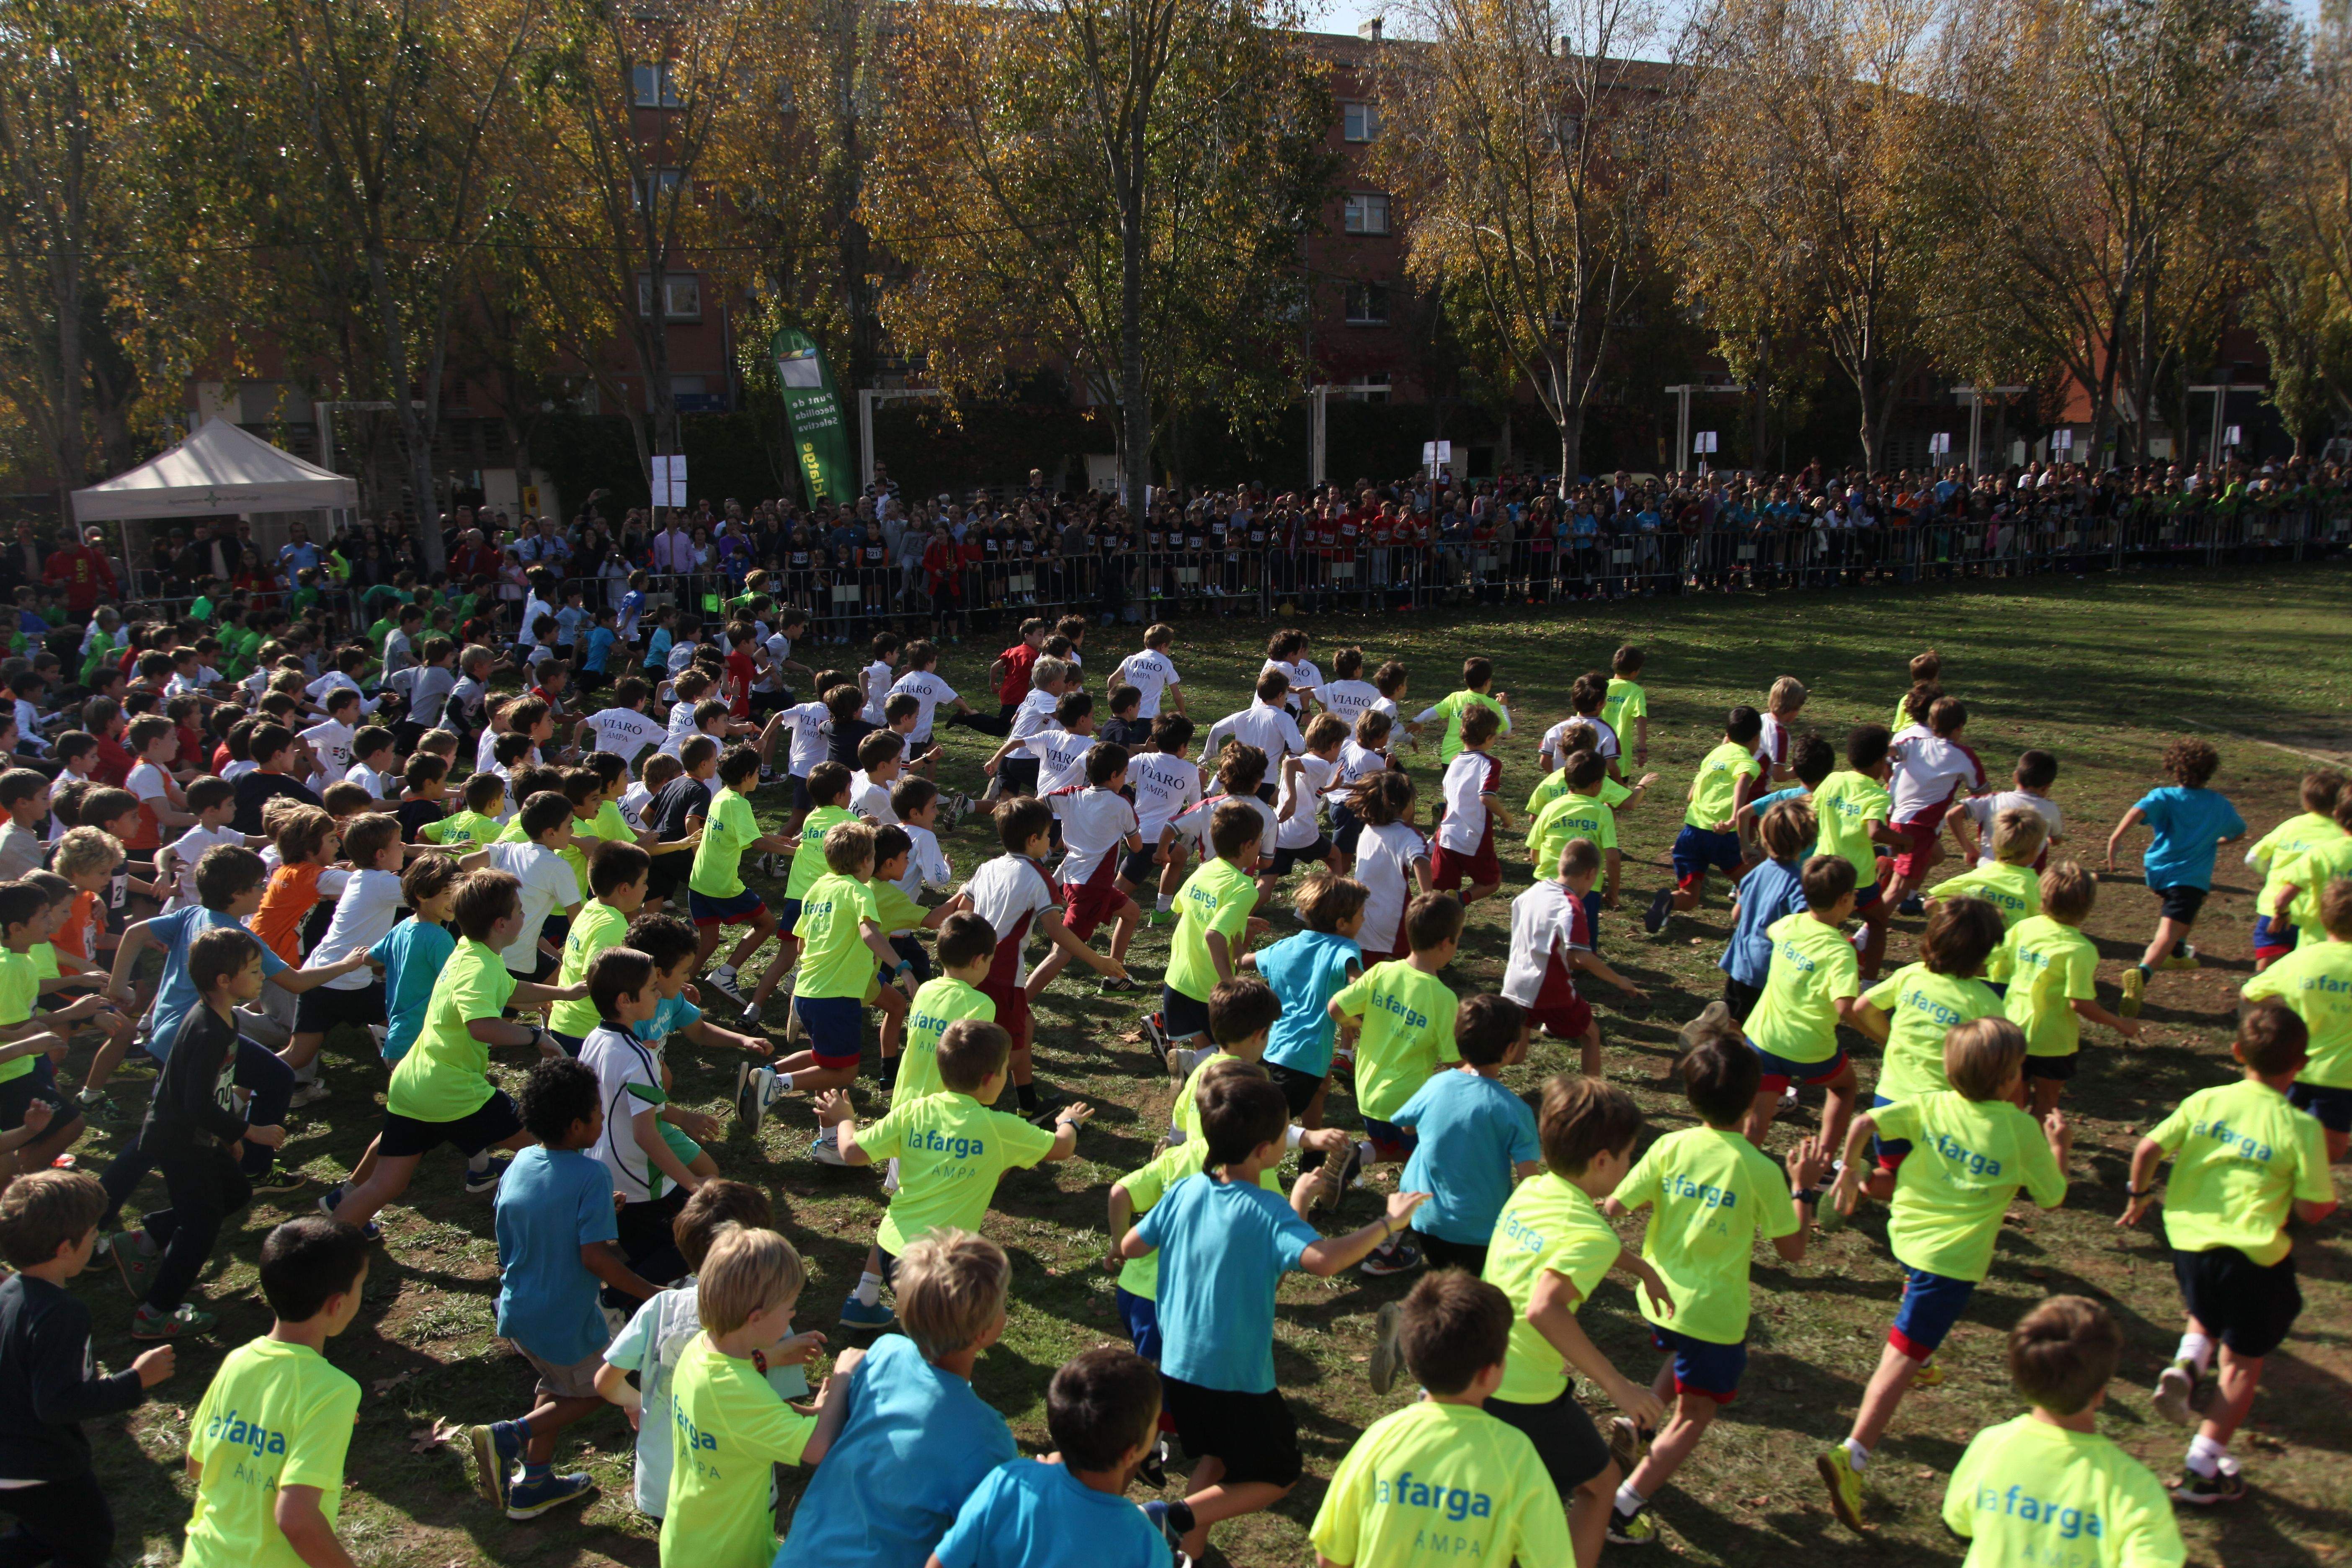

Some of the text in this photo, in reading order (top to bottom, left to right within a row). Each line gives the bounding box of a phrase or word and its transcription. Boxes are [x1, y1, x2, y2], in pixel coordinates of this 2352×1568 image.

[1133, 660, 1163, 672] IARÓ
[900, 685, 932, 695] VIARÓ
[1333, 694, 1371, 707] VIARÓ
[671, 712, 694, 726] IARÓ
[1337, 707, 1359, 716] AMPA
[603, 719, 642, 735] VIARÓ
[606, 732, 628, 742] AMPA
[802, 729, 823, 740] AMPA
[1141, 764, 1185, 790] VIARÓ
[1144, 783, 1168, 799] AMPA
[1561, 815, 1597, 831] farga
[804, 900, 832, 918] farga
[1189, 884, 1217, 909] farga
[1980, 886, 2025, 910] farga
[1782, 941, 1815, 972] farga
[1372, 988, 1427, 1029] la farga
[1911, 990, 1961, 1026] farga
[914, 1010, 948, 1037] farg
[908, 1127, 983, 1159] la farga
[2211, 1120, 2273, 1162] farga
[1937, 1133, 2002, 1176] farga
[931, 1165, 976, 1179] AMPA
[1675, 1173, 1737, 1209] farga
[220, 1409, 286, 1457] farga
[673, 1394, 717, 1452] farga
[1396, 1471, 1492, 1522] farga
[1976, 1479, 2103, 1540] la farga
[1414, 1529, 1482, 1558] AMPA
